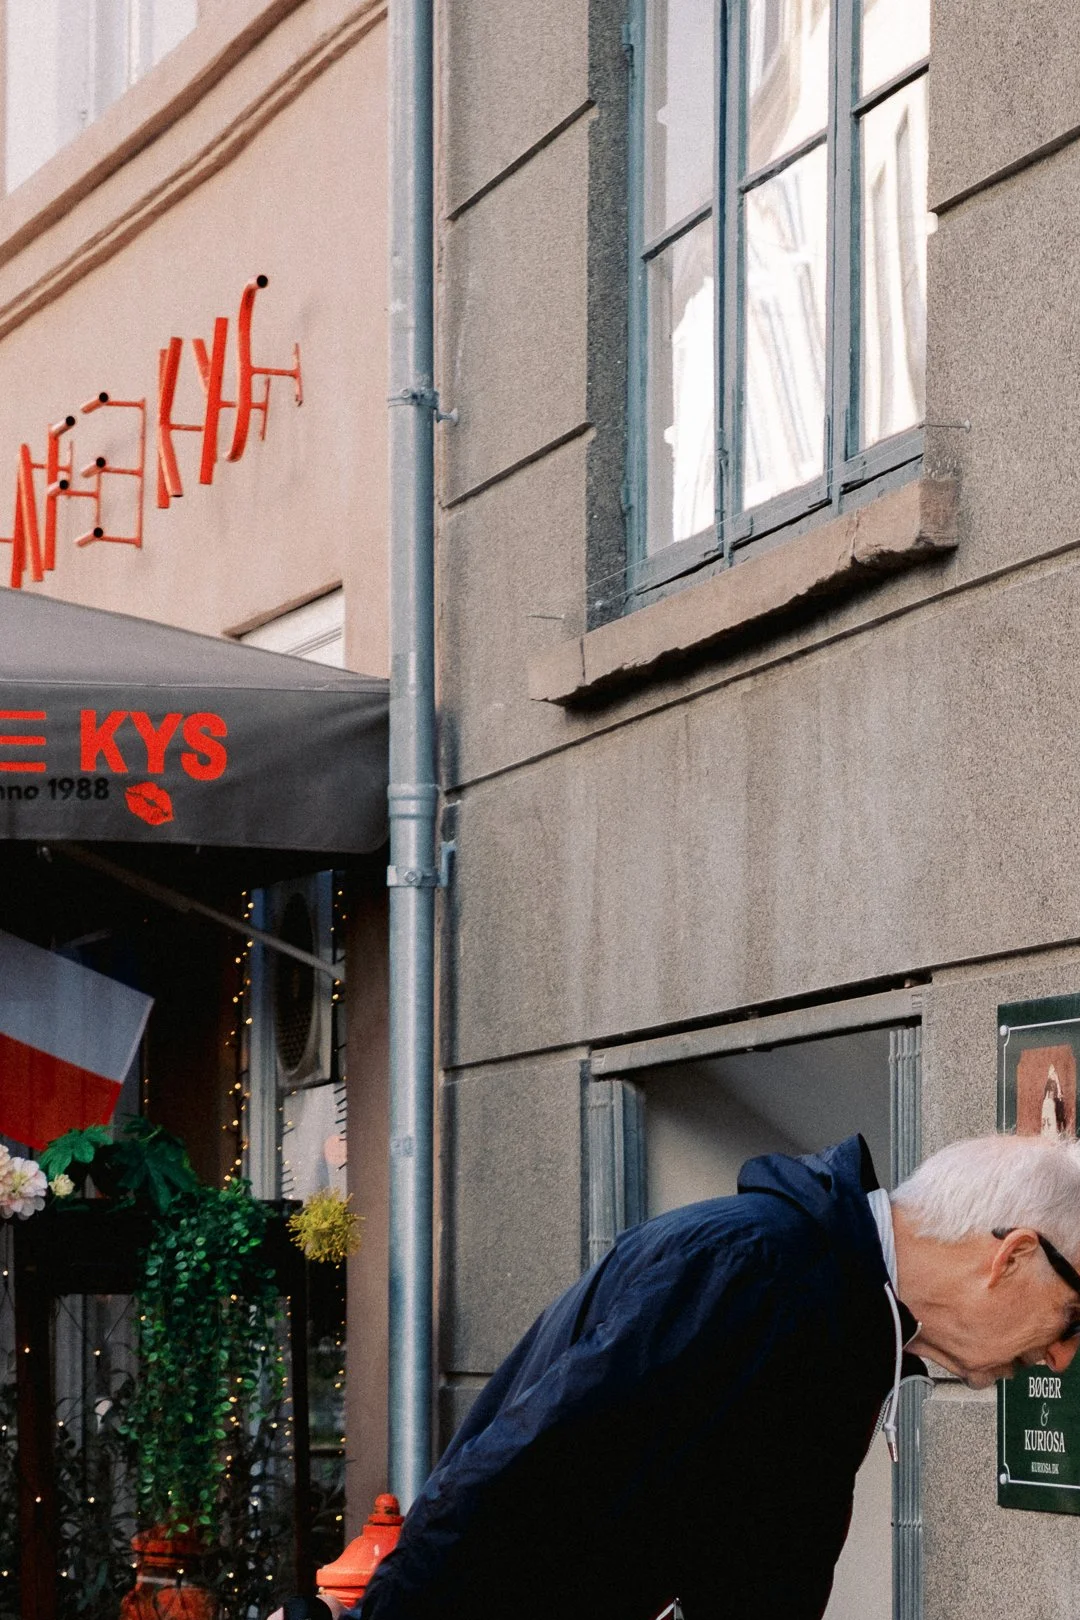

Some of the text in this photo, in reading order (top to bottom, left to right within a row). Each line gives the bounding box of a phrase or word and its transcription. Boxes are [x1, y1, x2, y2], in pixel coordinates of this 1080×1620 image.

[80, 709, 228, 781] KYS
[0, 777, 110, 801] no 1988
[1028, 1376, 1062, 1399] BØGER
[1040, 1402, 1050, 1427] &
[1024, 1429, 1066, 1453] KURIOSA
[1031, 1461, 1060, 1475] KURIOSA.DK
